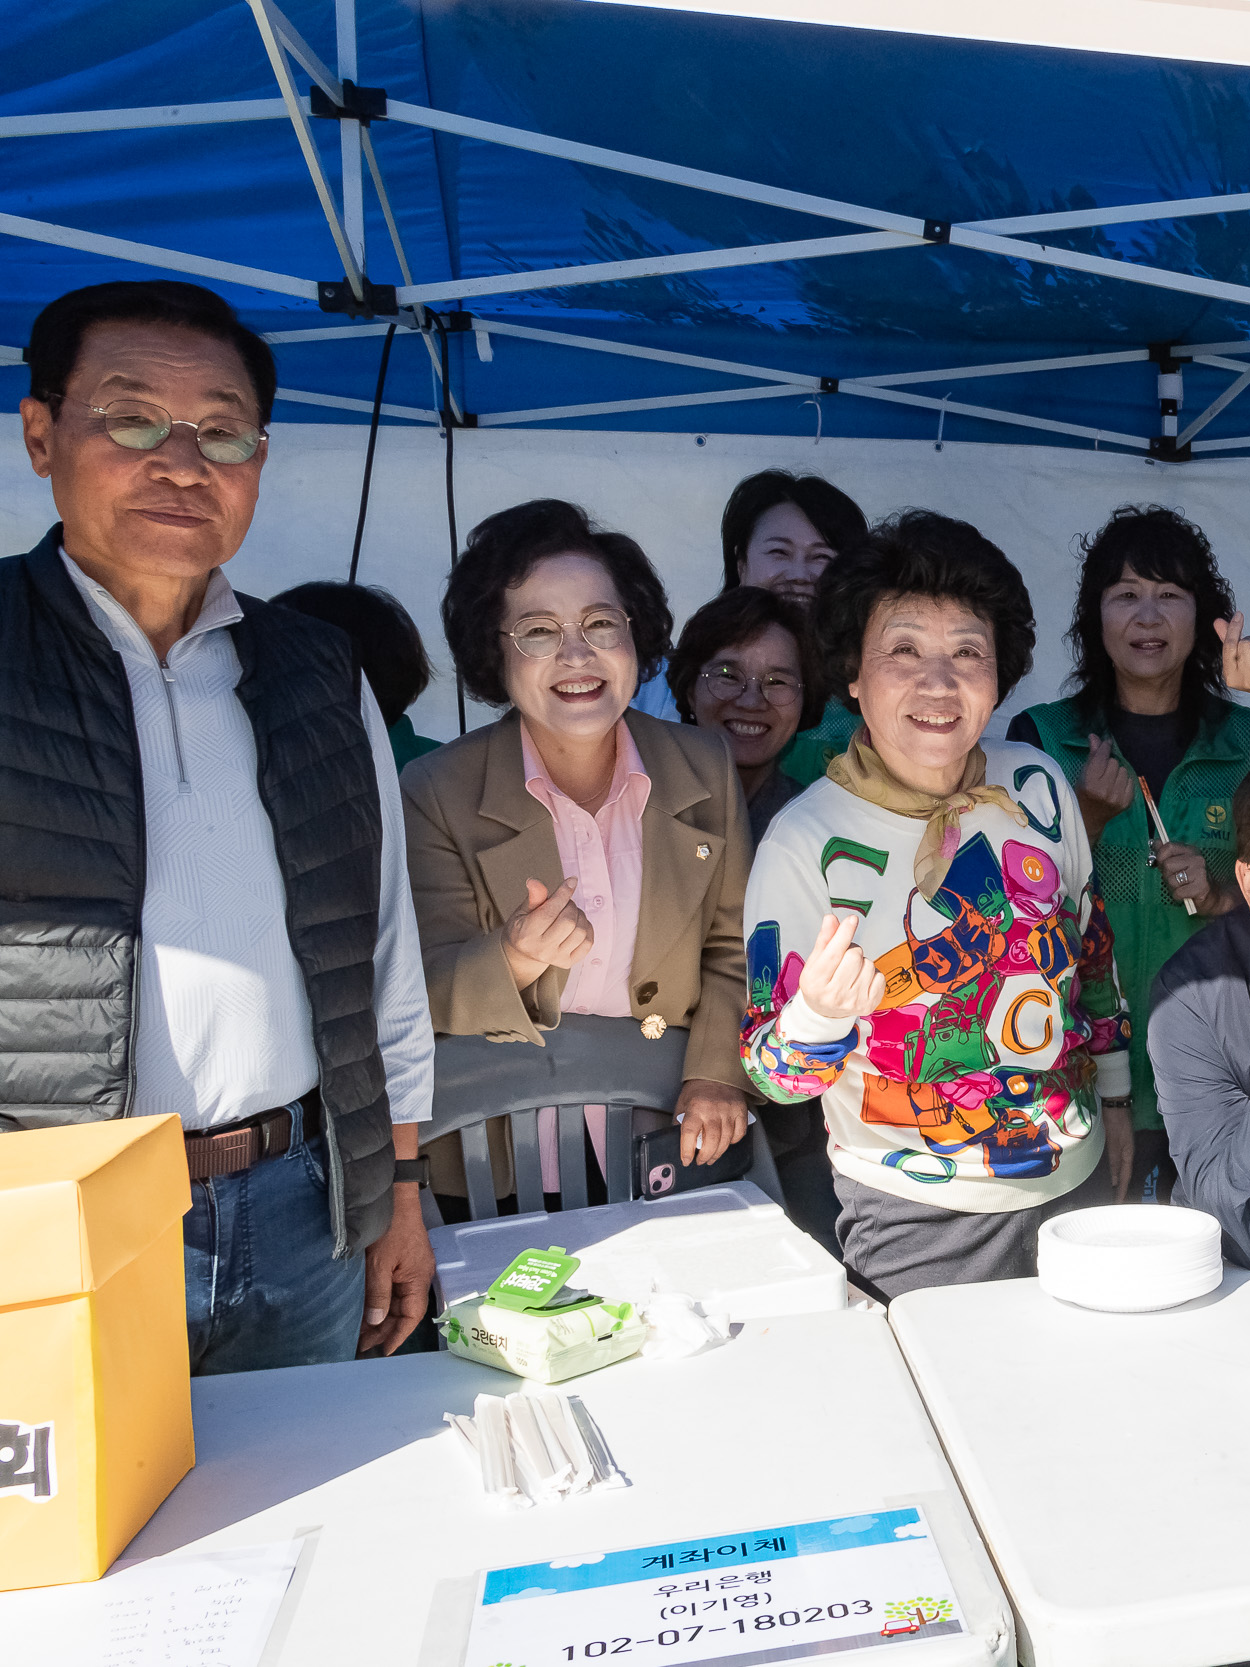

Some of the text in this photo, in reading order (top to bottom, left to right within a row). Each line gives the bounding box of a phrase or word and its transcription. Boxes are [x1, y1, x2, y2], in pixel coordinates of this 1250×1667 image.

[471, 1327, 508, 1351] 그린터치
[641, 1536, 787, 1569] 계좌이체
[653, 1569, 773, 1598] 우리은행
[660, 1592, 773, 1620] (이기영)
[562, 1600, 874, 1661] 102-07-180203
